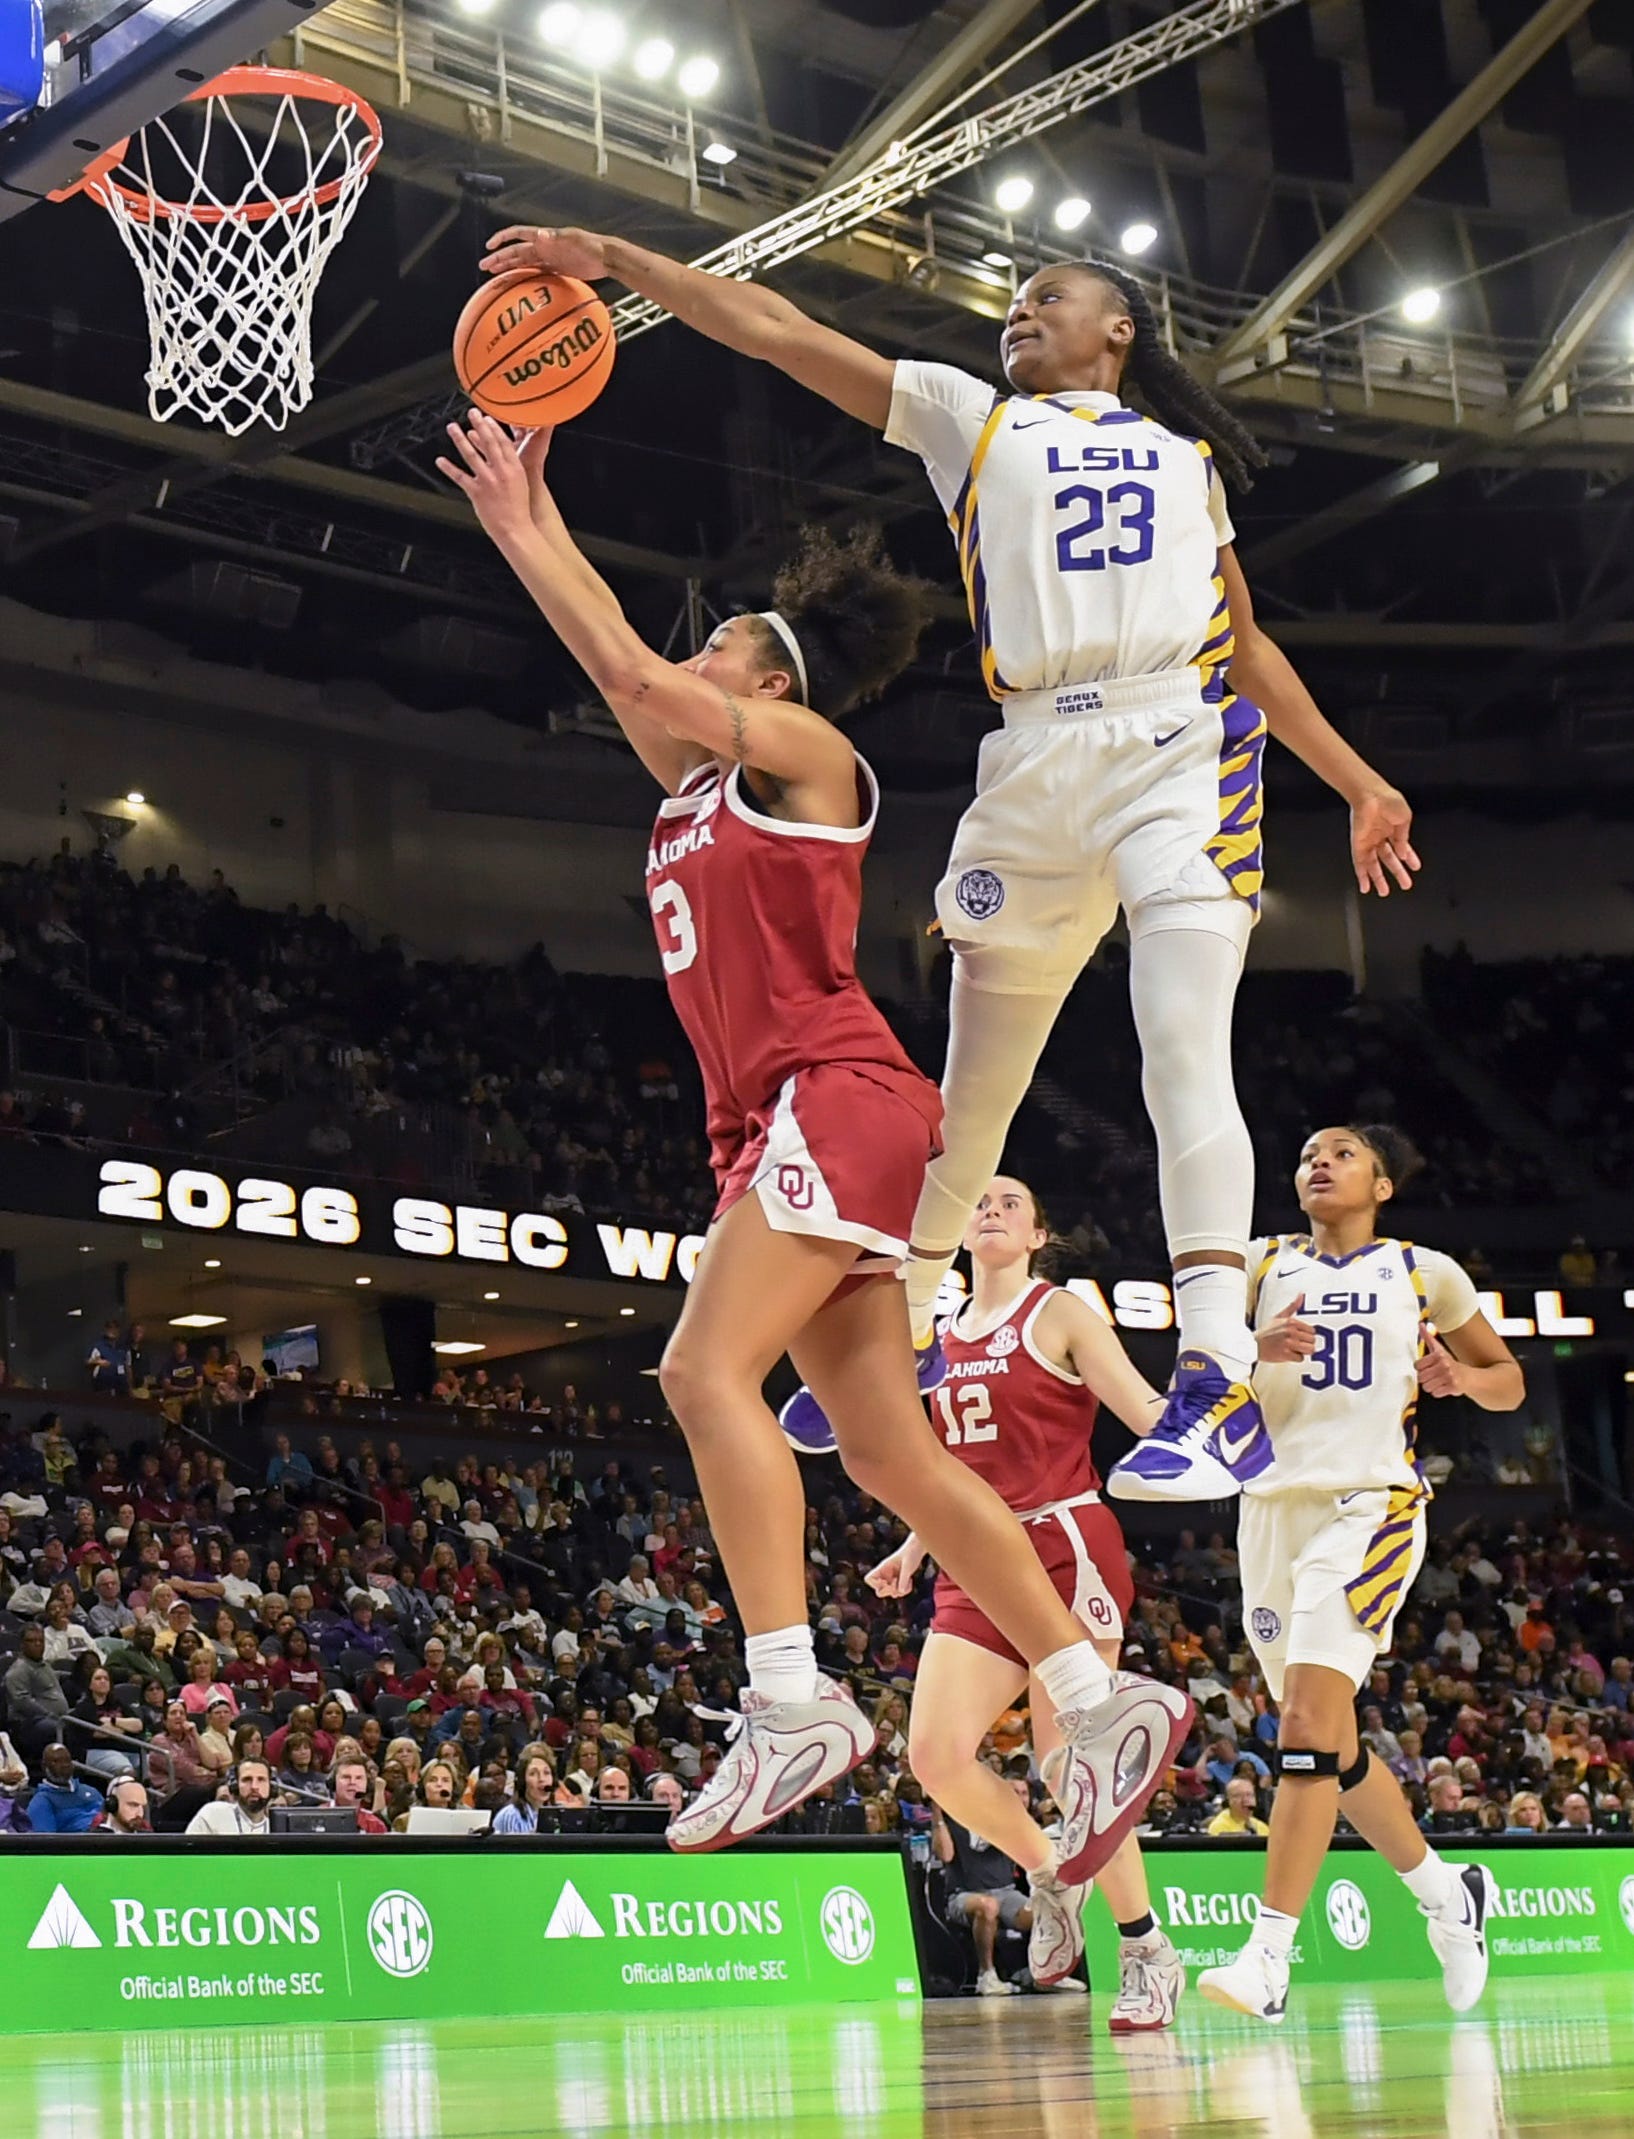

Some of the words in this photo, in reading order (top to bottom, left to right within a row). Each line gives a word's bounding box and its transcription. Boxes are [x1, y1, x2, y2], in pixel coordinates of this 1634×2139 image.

[503, 316, 602, 387] Wilson
[1047, 447, 1159, 473] LSU
[1055, 481, 1155, 572] 23
[1054, 701, 1103, 714] TIGERS
[645, 824, 715, 877] AOMA
[651, 879, 697, 975] 3
[778, 1165, 814, 1210] OU
[98, 1160, 361, 1245] 2026
[393, 1197, 569, 1270] SEC
[1296, 1292, 1378, 1316] LSU
[944, 1358, 1009, 1380] LAHOMA
[1301, 1324, 1374, 1391] 30
[936, 1384, 998, 1446] 12
[1088, 1597, 1112, 1625] OU
[824, 1891, 871, 1959] SEC
[1163, 1886, 1262, 1926] REGIO
[1330, 1885, 1367, 1944] SEC
[371, 1896, 428, 1971] SEC
[1216, 1947, 1241, 1966] Ban
[120, 1975, 184, 2000] Official
[187, 1974, 234, 1998] Bank
[237, 1973, 254, 1996] of
[257, 1973, 287, 1996] the
[290, 1972, 325, 1995] SEC
[621, 1963, 674, 1984] Official
[675, 1961, 714, 1983] Bank
[716, 1961, 731, 1981] of
[733, 1960, 758, 1981] the
[759, 1960, 788, 1980] SEC
